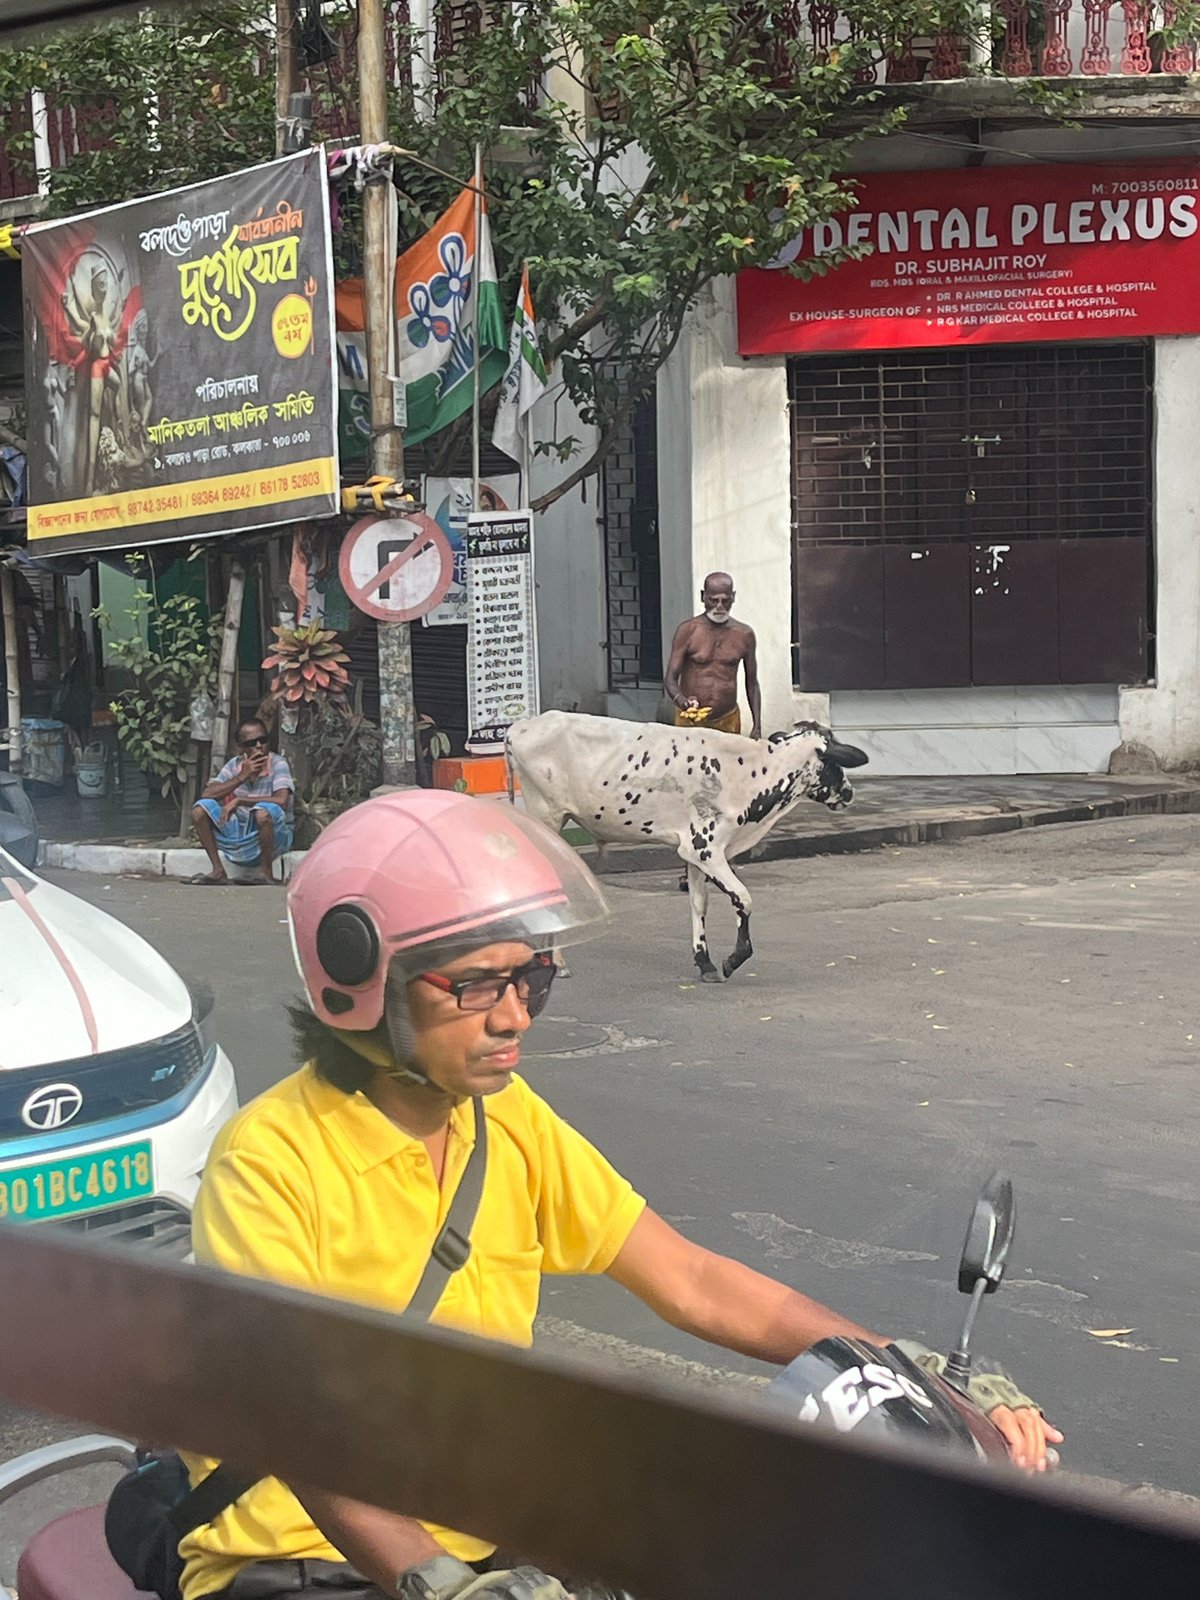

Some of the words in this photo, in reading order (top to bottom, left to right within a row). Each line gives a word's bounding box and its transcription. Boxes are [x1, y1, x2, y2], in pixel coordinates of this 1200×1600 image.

[1112, 178, 1198, 194] 7003560811
[812, 206, 998, 256] DENTAL
[1011, 194, 1198, 246] PLEXUS
[895, 261, 922, 275] DR.
[926, 255, 1009, 273] SUBHAJIT
[1012, 253, 1048, 270] ROY
[177, 225, 300, 341] দুর্গোৎসব
[954, 272, 1025, 284] MAXILLOFACIAL
[1027, 269, 1073, 281] SURGERY)
[965, 288, 1002, 300] AHMED
[1004, 286, 1044, 298] DENTAL
[1046, 284, 1094, 297] COLLEGE
[1096, 283, 1104, 294] &
[1105, 280, 1157, 293] HOSPITAL
[789, 311, 804, 322] EX
[905, 305, 921, 316] OF
[937, 303, 958, 315] NRS
[960, 301, 1006, 313] MEDICAL
[1008, 298, 1055, 311] COLLEGE
[1057, 298, 1065, 308] &
[1067, 295, 1118, 308] HOSPITAL
[956, 313, 977, 326] KAR
[979, 312, 1025, 325] MEDICAL
[1027, 309, 1075, 322] COLLEGE
[1076, 309, 1084, 319] &
[1087, 306, 1138, 319] HOSPITAL
[196, 373, 259, 402] পরিচালনায়
[147, 414, 211, 445] মানিকতলা
[212, 401, 269, 433] আঞ্চলিক
[272, 390, 315, 422] সমিতি
